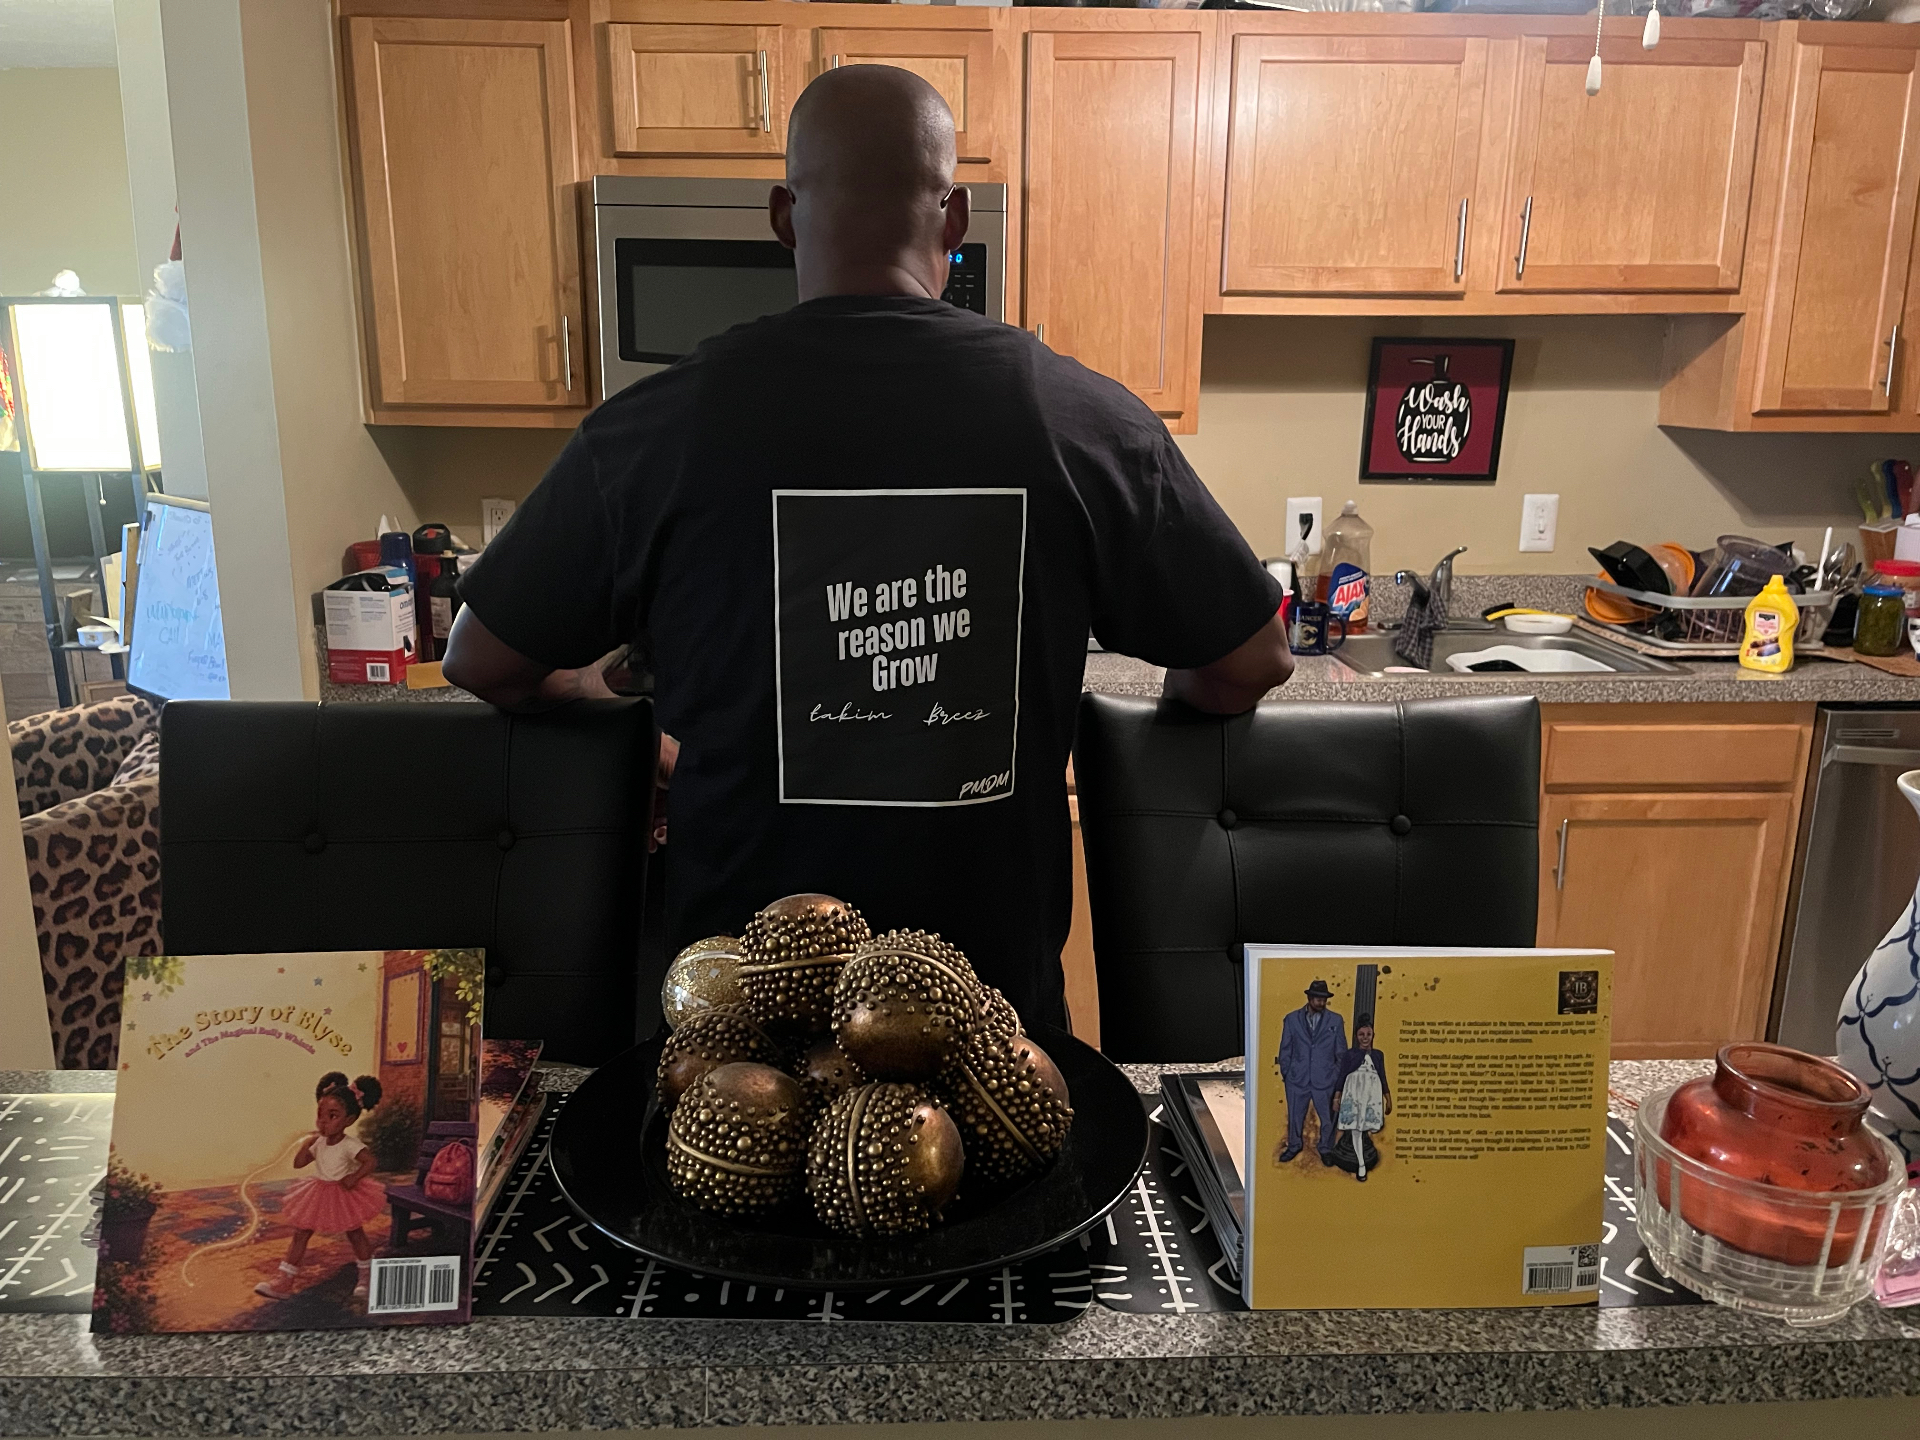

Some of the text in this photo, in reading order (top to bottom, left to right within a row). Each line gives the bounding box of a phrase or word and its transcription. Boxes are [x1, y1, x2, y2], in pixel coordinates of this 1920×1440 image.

[1404, 383, 1469, 413] Wash
[1397, 415, 1462, 457] Hands
[1421, 414, 1446, 430] YOUR
[826, 564, 967, 622] We are the
[1334, 578, 1365, 607] AJAX
[838, 608, 971, 661] reason we
[872, 653, 938, 692] Grow
[958, 770, 1010, 800] PMDM
[147, 1005, 353, 1060] The Story of Elyse
[201, 1034, 219, 1047] The
[220, 1026, 258, 1039] Magical
